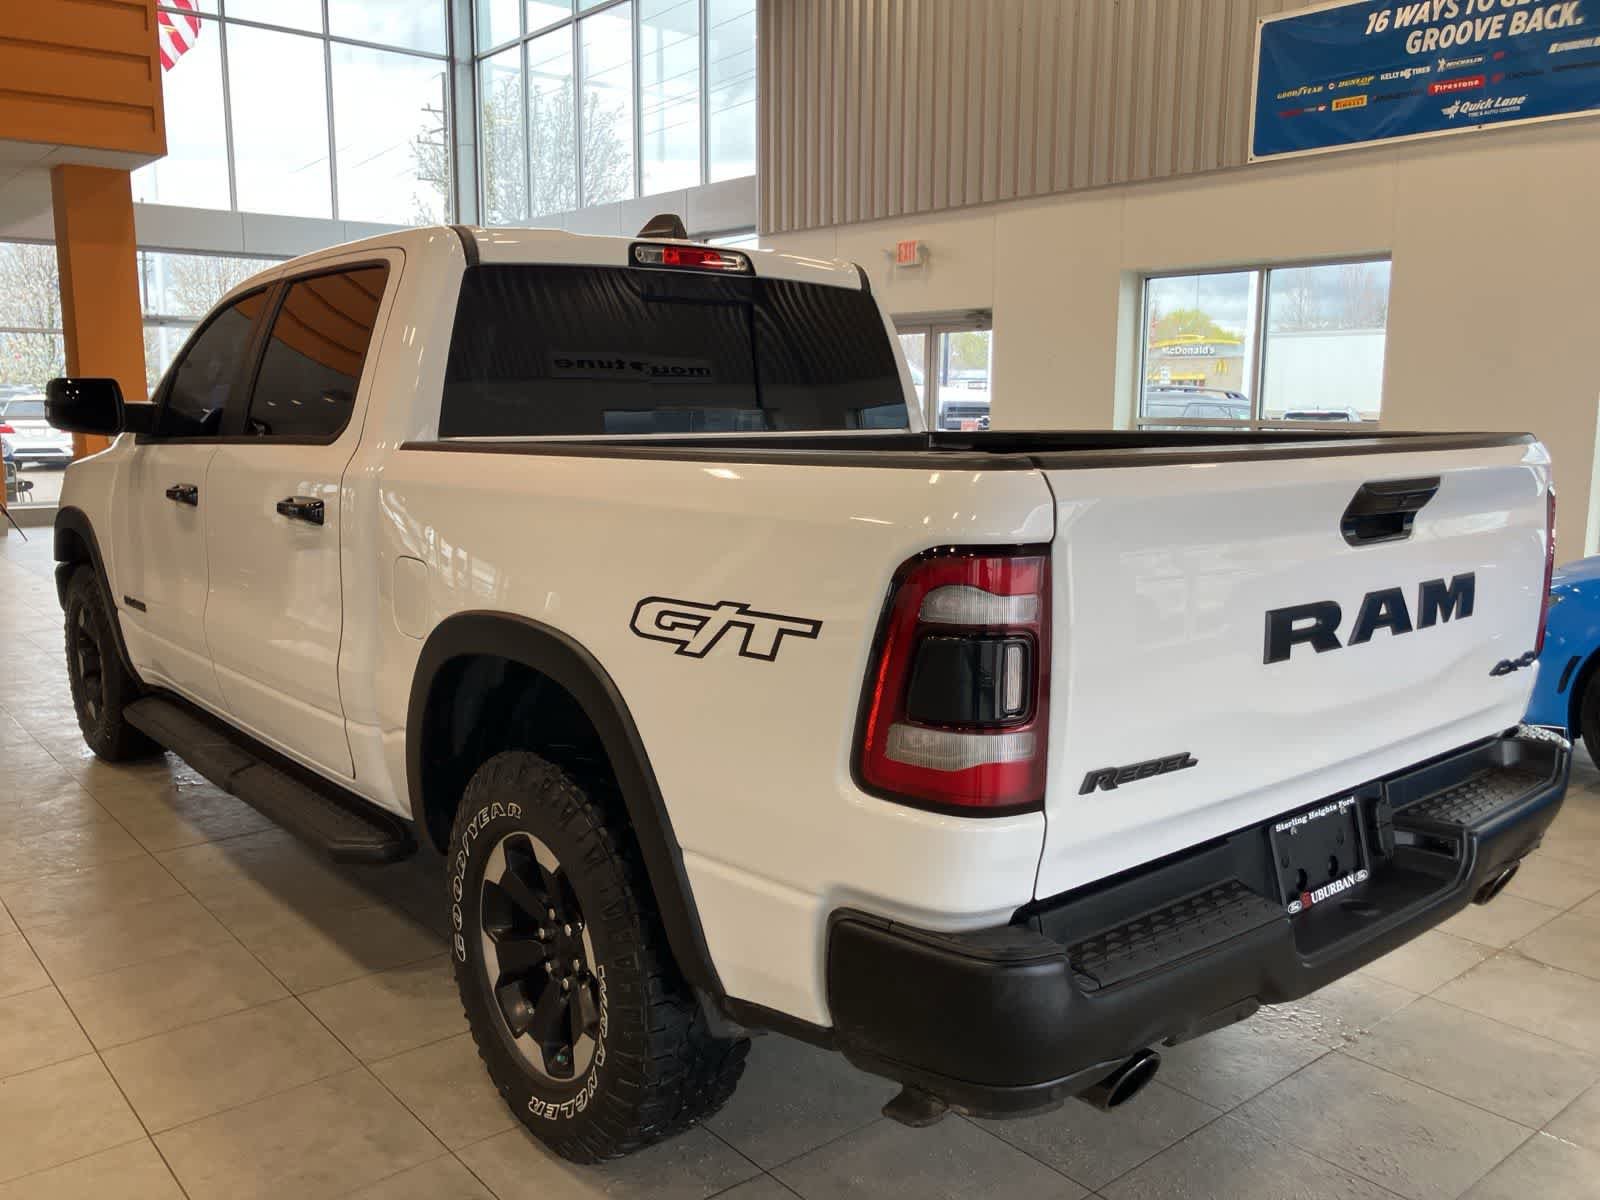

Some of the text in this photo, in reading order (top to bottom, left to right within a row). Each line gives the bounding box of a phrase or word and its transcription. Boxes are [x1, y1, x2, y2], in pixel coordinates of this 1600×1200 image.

[1365, 9, 1391, 35] 16
[1393, 0, 1459, 29] WAYS
[1405, 14, 1506, 54] GROOVE
[1508, 2, 1585, 36] BACK.
[1380, 71, 1399, 81] KELLY
[1446, 56, 1484, 68] MICHELIN
[1277, 86, 1324, 99] GOODYEAR
[1338, 76, 1375, 88] DUNLOP
[1460, 95, 1526, 113] Quick Lane
[897, 240, 917, 264] EXIT
[1162, 344, 1216, 356] McDonald's
[1263, 571, 1475, 665] RAM
[1275, 796, 1355, 832] Sterling Heights Ford
[453, 802, 522, 962] GOODYEAR
[1300, 874, 1356, 909] SUBURBAN
[528, 965, 608, 1120] WRANGLER
